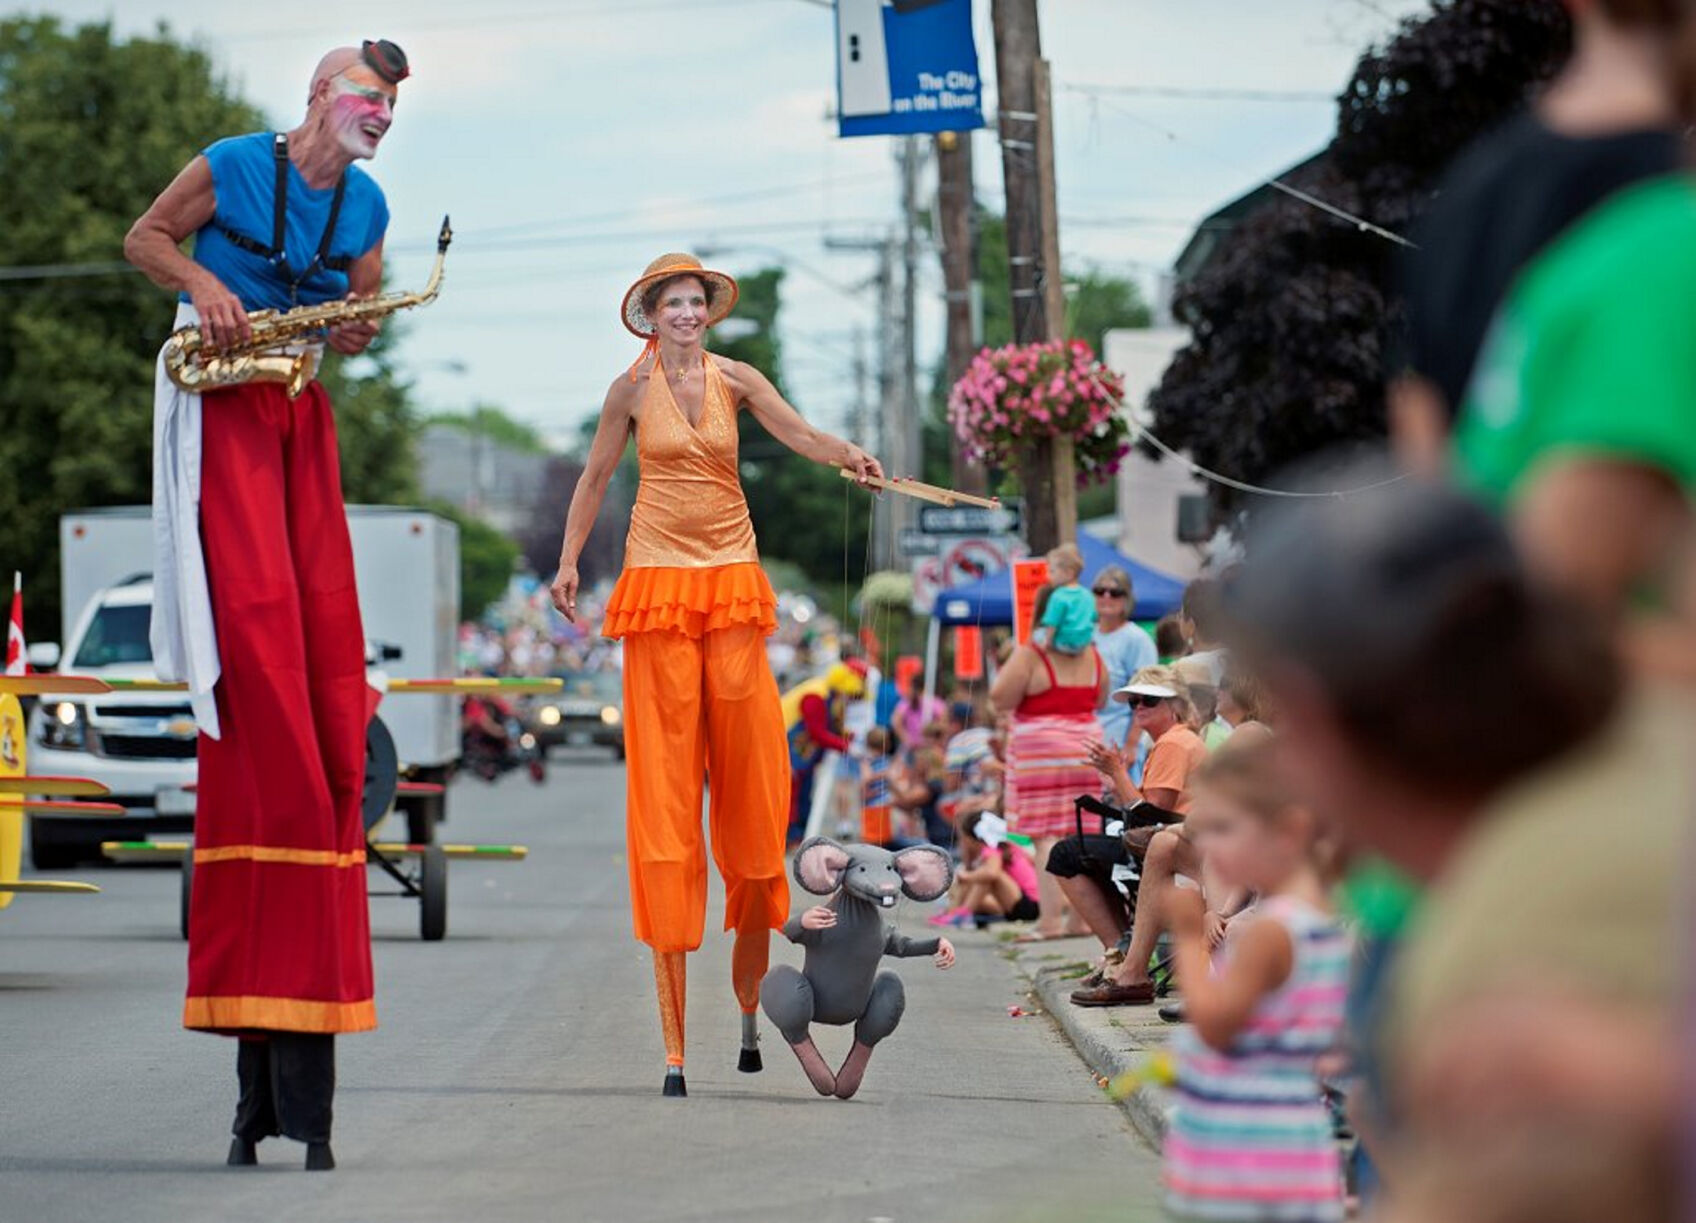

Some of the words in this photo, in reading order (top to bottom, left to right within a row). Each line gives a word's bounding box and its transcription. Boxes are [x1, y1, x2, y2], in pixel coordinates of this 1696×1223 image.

[918, 72, 944, 90] The
[946, 70, 977, 91] City
[893, 98, 912, 112] on
[913, 94, 938, 111] the
[939, 91, 977, 109] River
